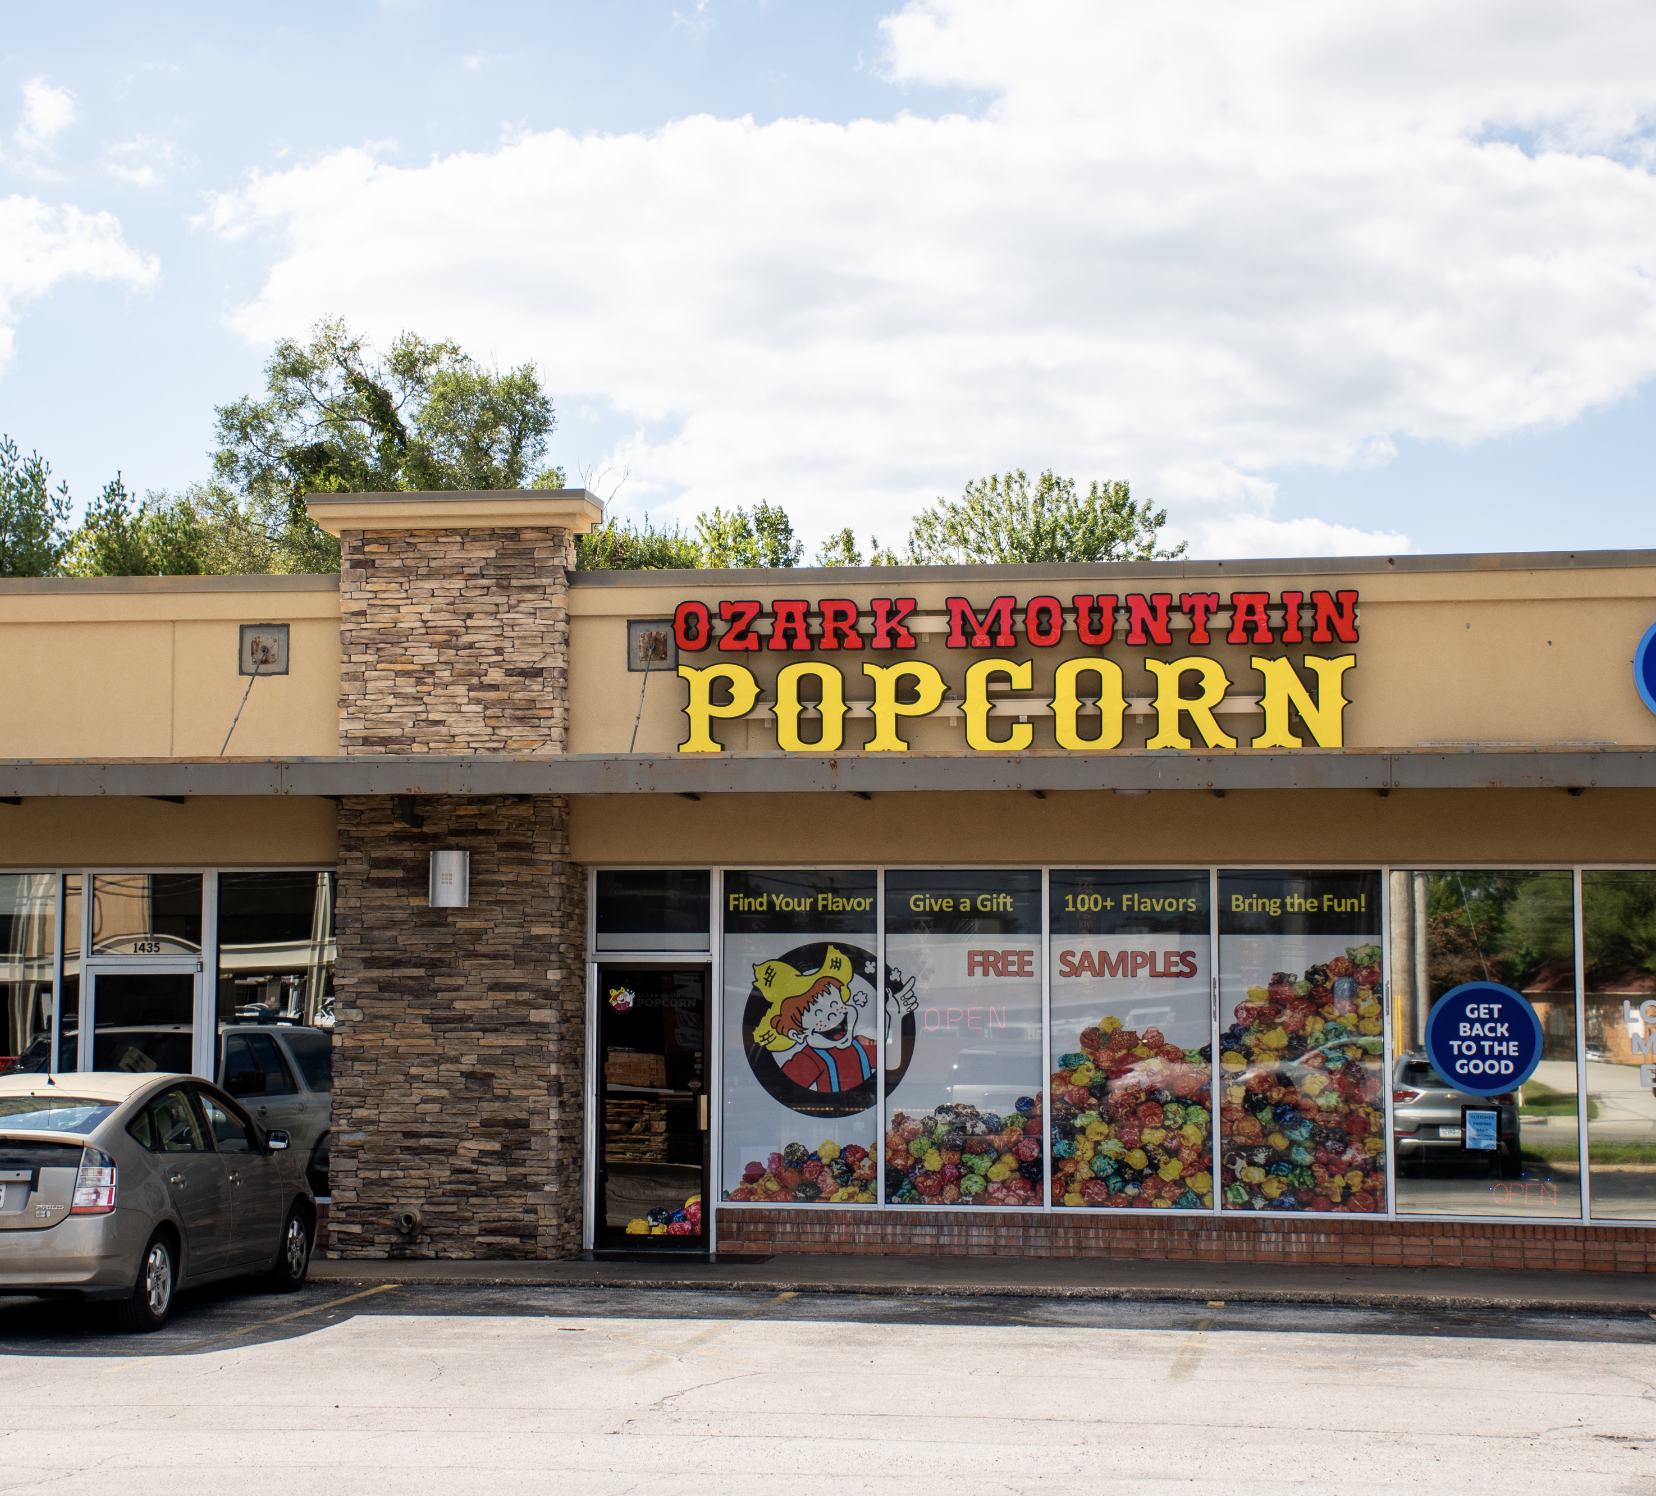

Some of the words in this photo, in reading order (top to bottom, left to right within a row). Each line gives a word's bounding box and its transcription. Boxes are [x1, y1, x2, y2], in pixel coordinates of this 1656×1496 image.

[672, 597, 918, 651] OZARK
[945, 590, 1360, 649] MOUNTAIN
[677, 653, 1357, 753] POPCORN
[729, 892, 768, 911] Find
[771, 893, 814, 911] Your
[817, 892, 874, 911] Flavor
[909, 894, 954, 912] Give
[959, 898, 971, 912] a
[976, 893, 1014, 912] Gift
[1064, 894, 1115, 912] 100+
[1122, 893, 1197, 912] Flavors
[1231, 893, 1282, 917] Bring
[1285, 893, 1319, 912] the
[1323, 893, 1366, 912] Fun!
[133, 942, 161, 953] 1435
[967, 949, 1034, 977] FREE
[1059, 949, 1198, 978] SAMPLES
[636, 998, 697, 1007] POPCORN
[1465, 1003, 1503, 1018] GET
[924, 1006, 1006, 1031] OPEN
[1459, 1022, 1509, 1037] BACK
[1449, 1041, 1477, 1055] TO
[1480, 1041, 1519, 1056] THE
[1455, 1059, 1514, 1074] GOOD
[1493, 1182, 1557, 1206] OPEN
